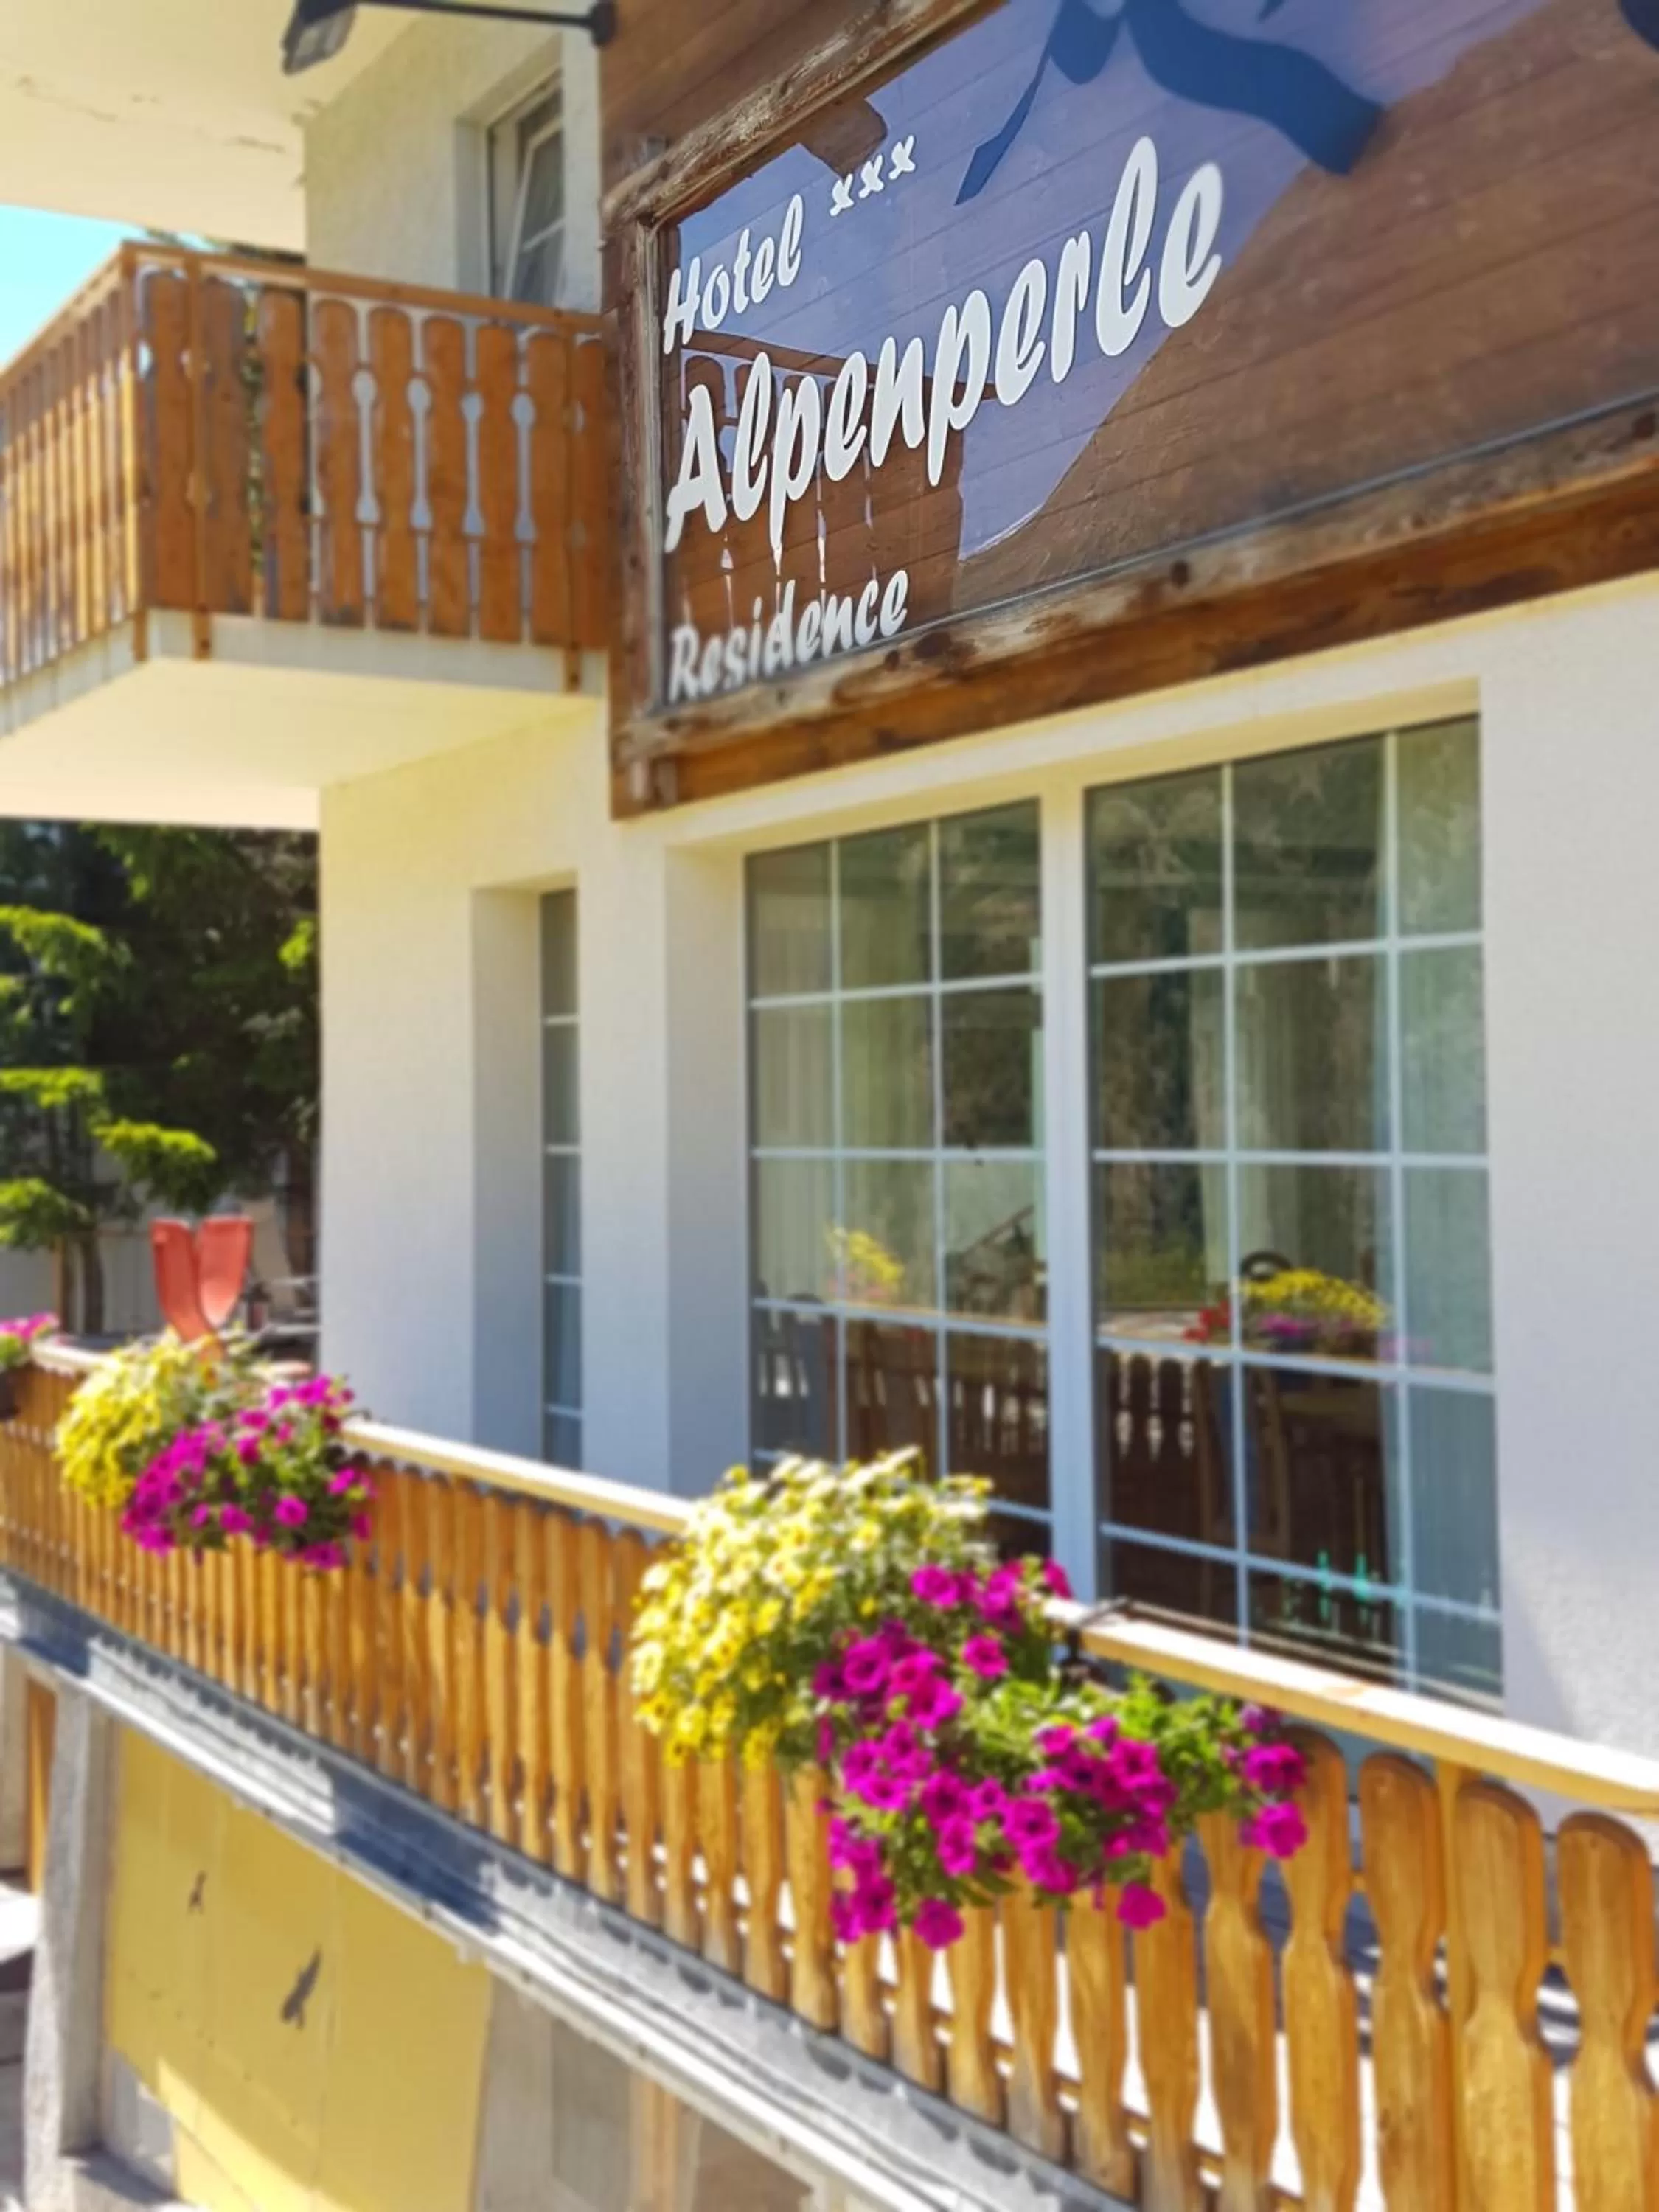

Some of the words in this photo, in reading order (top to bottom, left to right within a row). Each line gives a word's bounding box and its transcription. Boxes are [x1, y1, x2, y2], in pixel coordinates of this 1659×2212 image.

[664, 195, 803, 355] Hotel
[664, 136, 1222, 552] Alpenperle
[668, 569, 908, 703] Residence
